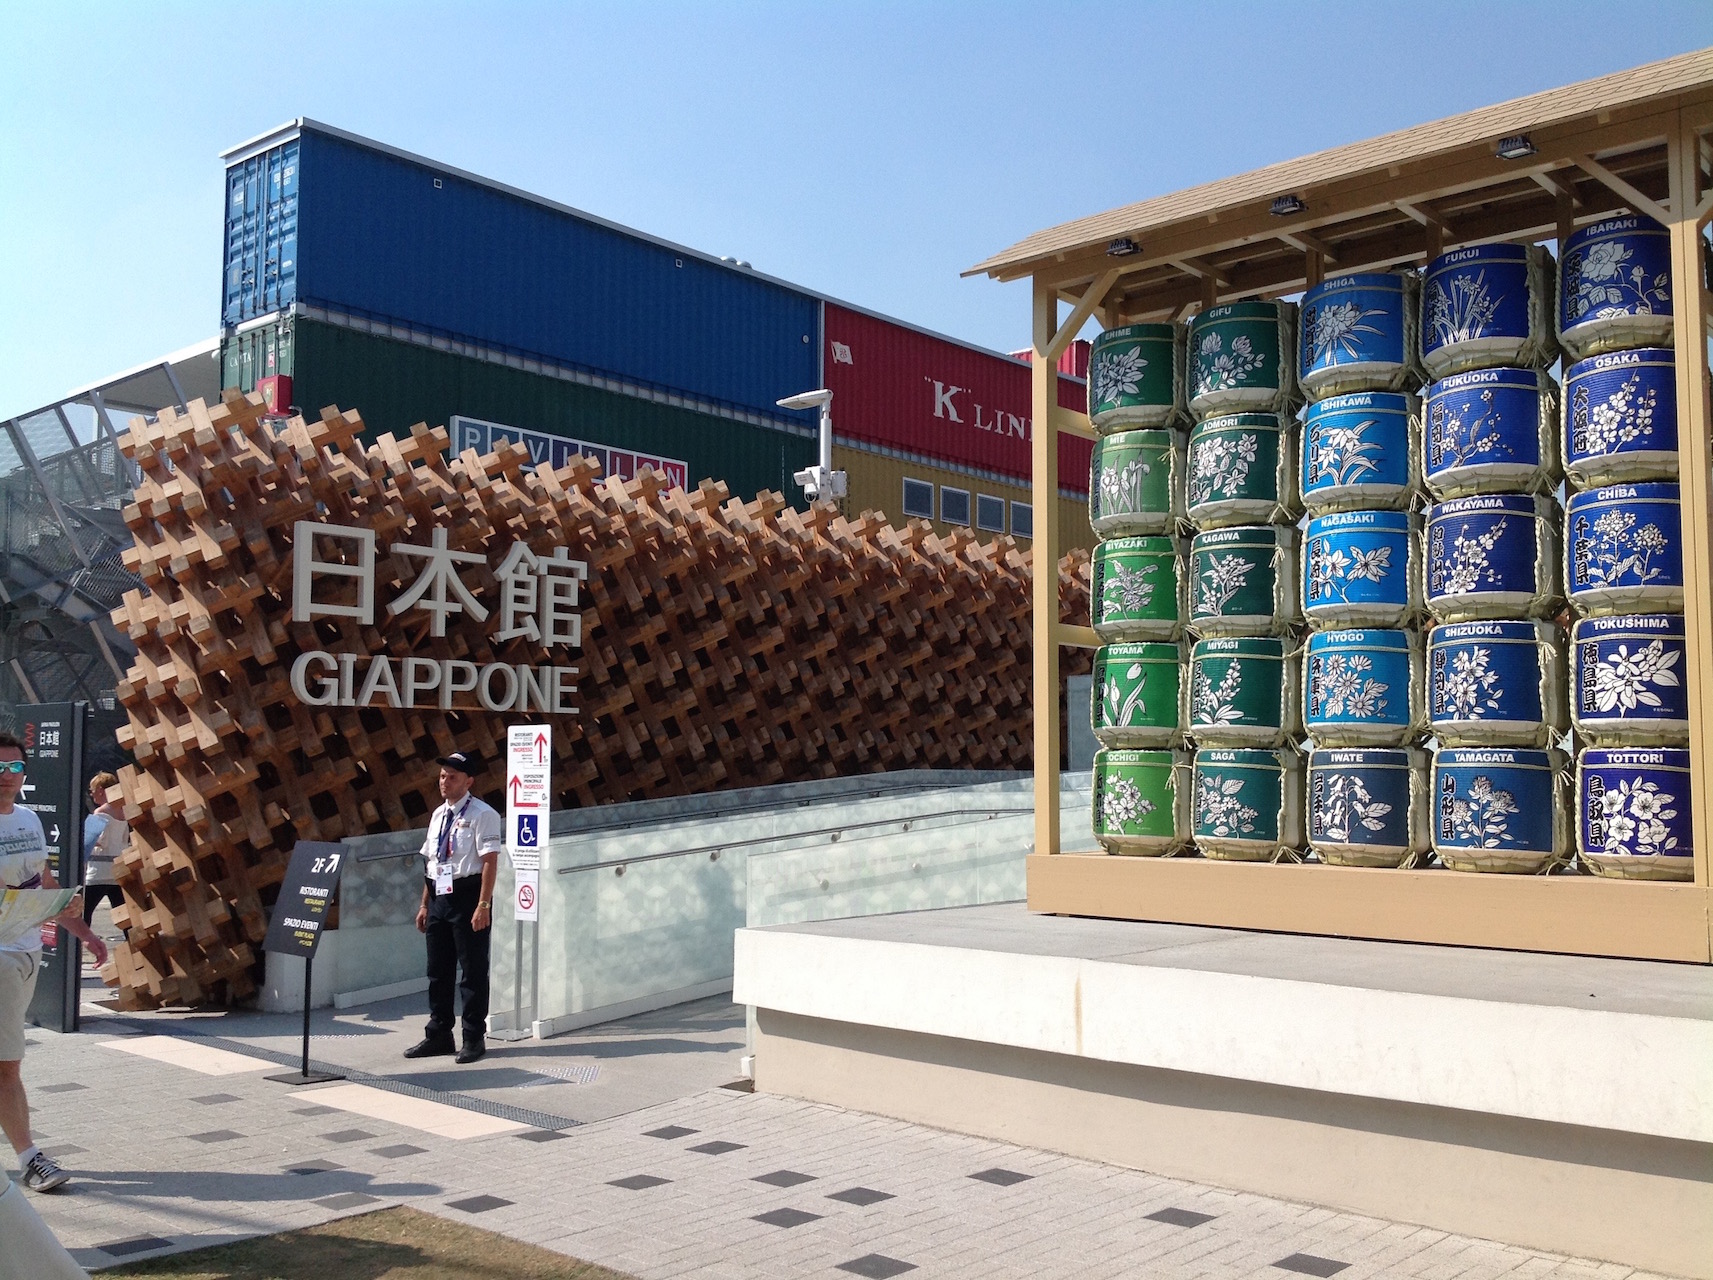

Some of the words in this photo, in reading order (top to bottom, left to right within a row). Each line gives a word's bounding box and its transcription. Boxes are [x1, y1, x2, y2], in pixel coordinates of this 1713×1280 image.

[1586, 218, 1638, 237] IBARAKI
[1445, 248, 1480, 264] FUKUI
[1324, 277, 1356, 291] SHIGA
[1209, 306, 1232, 318] GIFU
[1105, 327, 1132, 340] EHIME
[1595, 353, 1641, 368] OSAKA
[1442, 372, 1499, 389] FUKUOKA
[1320, 396, 1372, 411] ISHIKAWA
[1202, 418, 1238, 431] AOMORI
[1109, 435, 1126, 445] MIE
[1597, 487, 1638, 500] CHIBA
[1442, 498, 1504, 514] WAKAYAMA
[1321, 514, 1375, 527] NAGASAKI
[1202, 532, 1240, 543] KAGAWA
[1105, 540, 1147, 551] MIYAZAKI
[1575, 515, 1590, 586] 千葉県
[292, 520, 588, 648] 日本館
[1593, 618, 1670, 630] TOKUSHIMA
[1327, 632, 1365, 643] HYOGO
[1444, 625, 1503, 637] SHIZUOKA
[1108, 646, 1144, 655] TOYAMA
[1207, 641, 1239, 650] MIYAGI
[290, 651, 580, 714] GIAPPONE
[1210, 752, 1236, 761] SAGA
[1330, 753, 1364, 763] IWATE
[1454, 753, 1516, 763] YAMAGATA
[1606, 753, 1664, 764] TOTTORI
[311, 857, 326, 874] 2F
